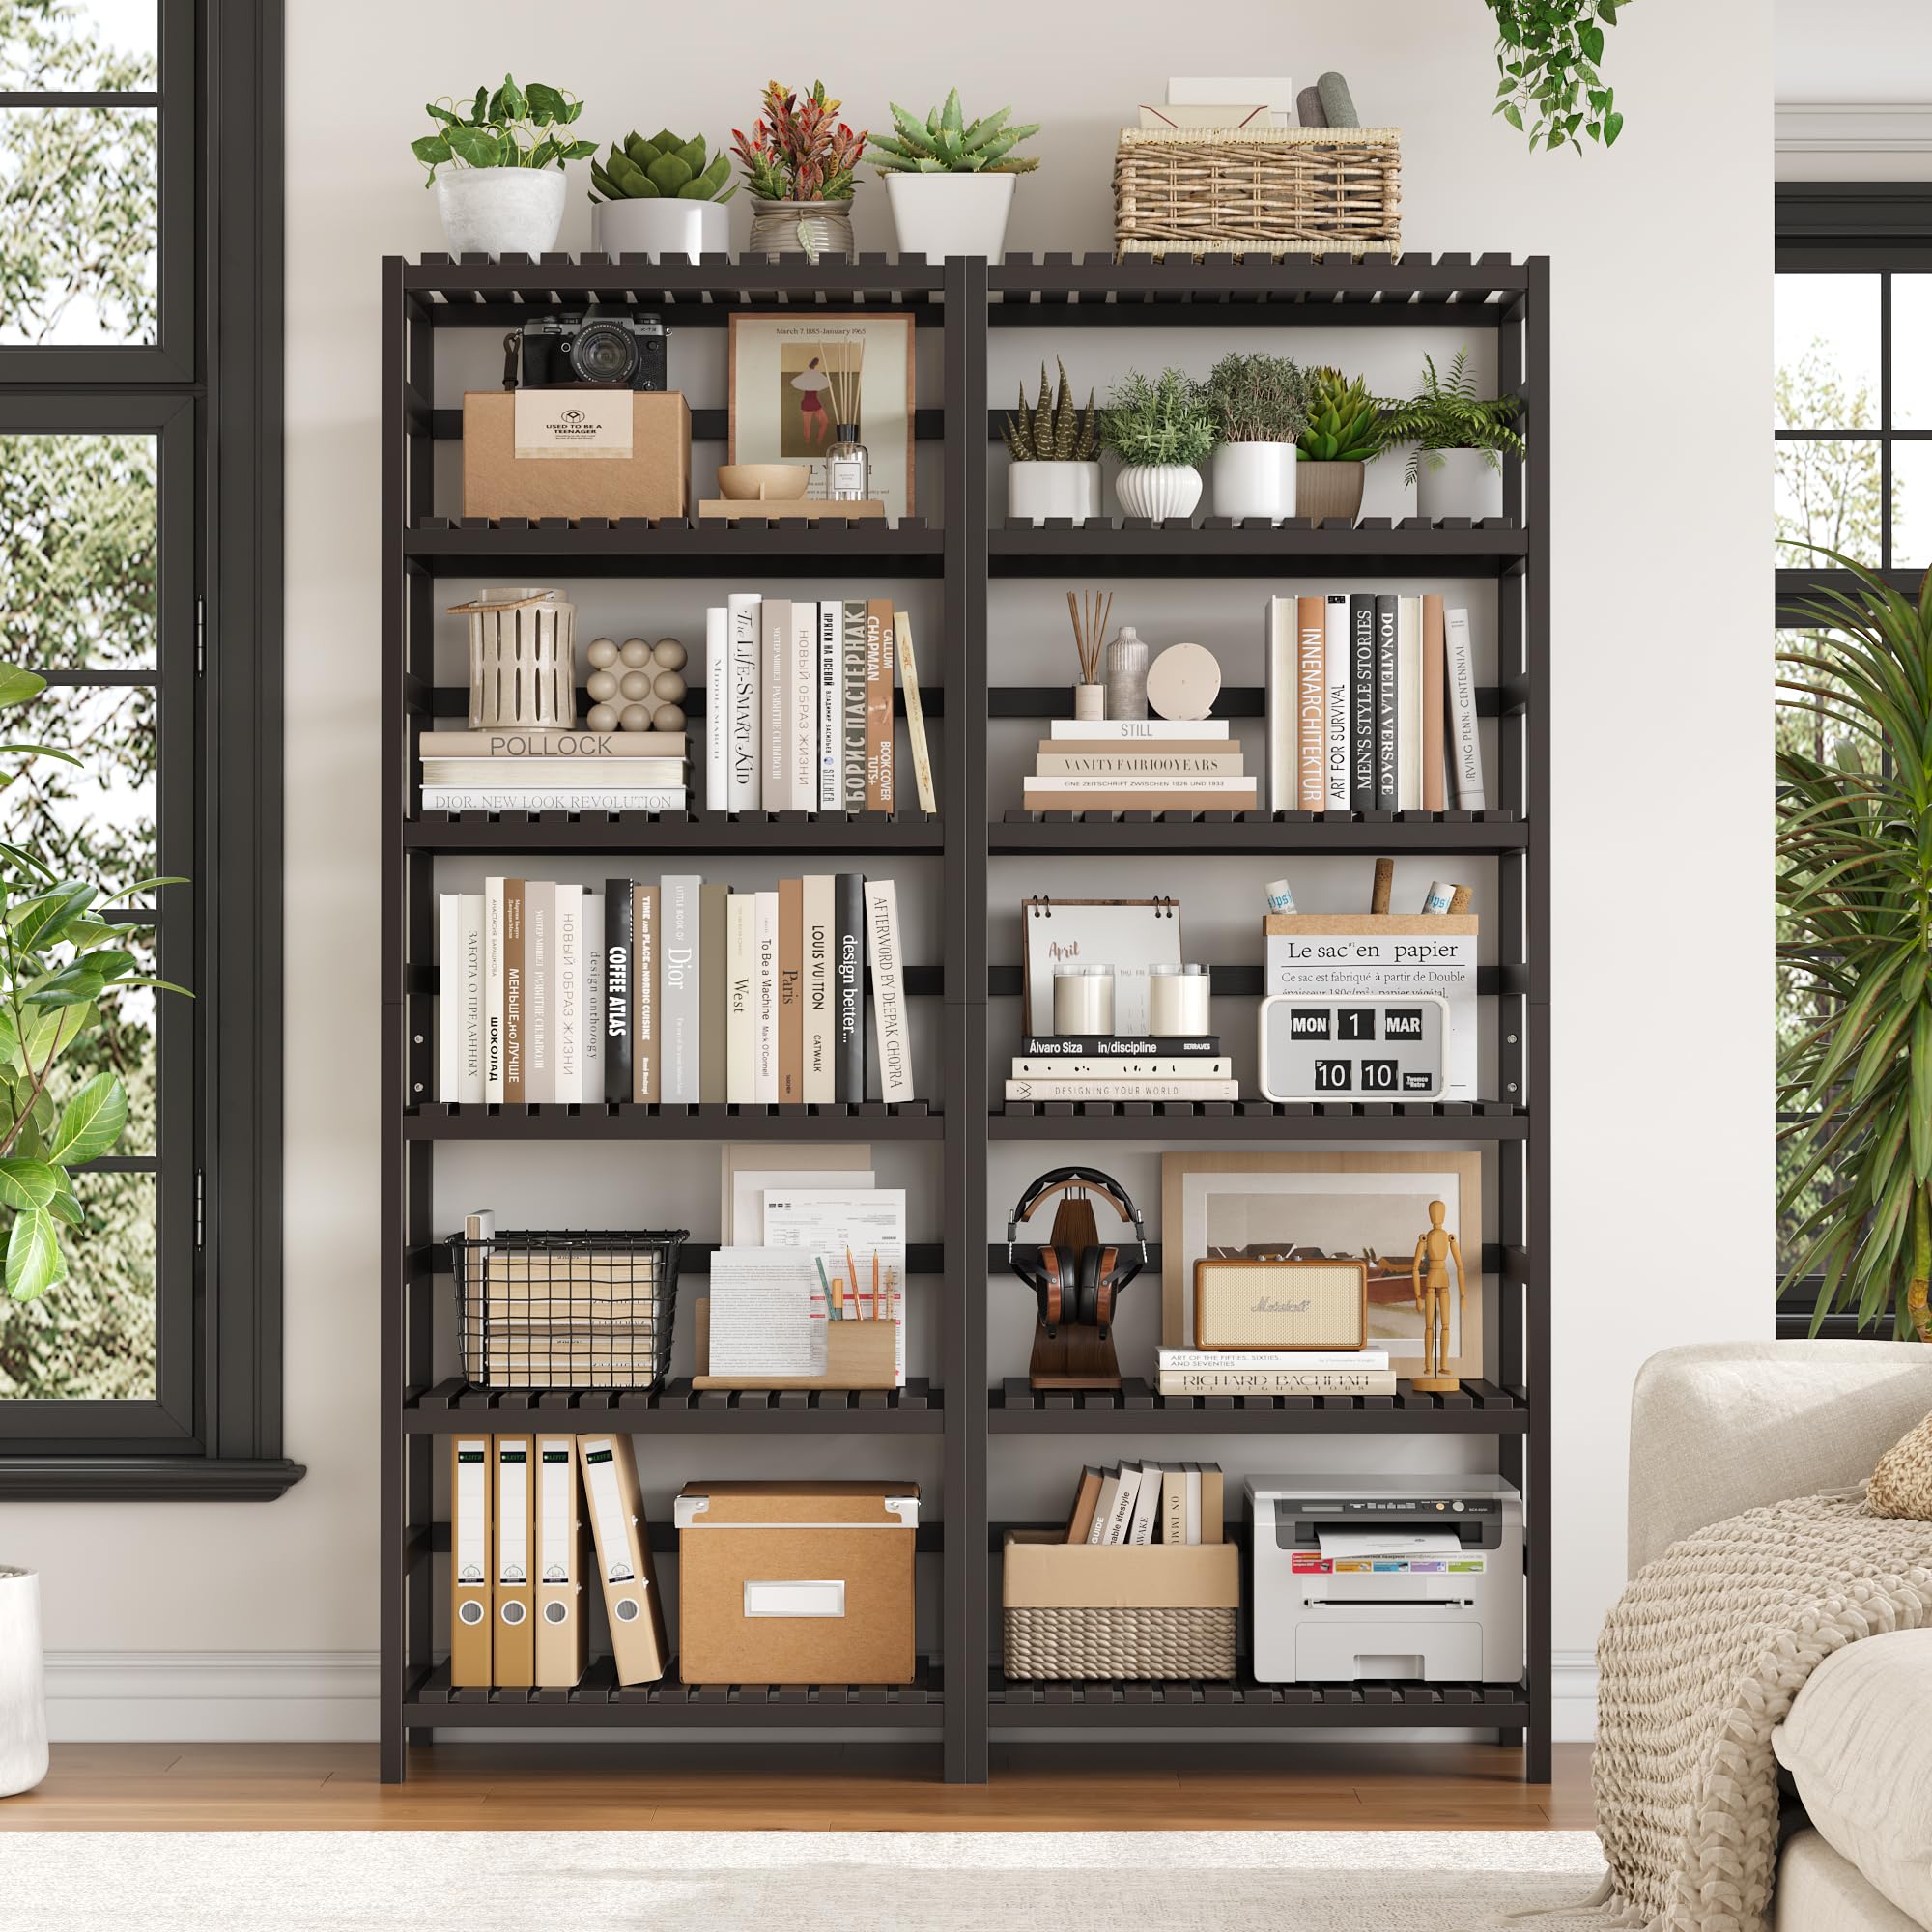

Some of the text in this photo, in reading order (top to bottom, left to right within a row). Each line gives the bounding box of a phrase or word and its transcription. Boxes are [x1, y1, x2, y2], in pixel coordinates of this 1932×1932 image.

[737, 610, 753, 639] The
[823, 613, 835, 687] ПРЯТКИ НА ОСЕВОЙ
[867, 616, 879, 681] CHAPMAN
[883, 629, 893, 668] CALLUM
[1356, 610, 1372, 680] STORIES
[798, 630, 810, 785] НОВЫЙ ОБРАЗ ЖИЗНИ
[845, 611, 866, 802] БОРИС ПАСТЕРНАК
[1302, 628, 1321, 801] INNENARCHITEKTUR
[1356, 683, 1372, 735] STYLE
[1381, 612, 1394, 795] DONATELLA VERSACE
[1456, 644, 1476, 782] IRVING PENN: CENTENNIAL
[491, 735, 613, 755] POLLOCK
[1121, 724, 1153, 737] STILL
[1330, 684, 1346, 800] ART FOR SURVIVAL
[881, 741, 892, 801] BOOK COVER
[1065, 759, 1113, 771] VANITY
[435, 795, 672, 809] DIOR. NEW LOOK REVOLUTION
[642, 895, 651, 920] TIME
[676, 886, 685, 907] LITTLE
[676, 910, 685, 929] BOOK
[761, 939, 772, 951] To
[761, 953, 772, 967] Be
[839, 934, 858, 984] design
[1048, 940, 1080, 962] April
[1287, 942, 1312, 959] Le
[1356, 945, 1380, 957] en
[1394, 941, 1459, 963] papier
[668, 948, 692, 989] Dior
[812, 925, 824, 1009] LOUIS VUITTON
[1281, 971, 1465, 987] Ce sac est fabriqué à partir de Double
[468, 930, 478, 1077] ЗАБОТА О ПРЕДАННЫХ
[563, 913, 576, 1075] НОВЫЙ ОБРАЗ ЖИЗНИ
[587, 951, 600, 1060] design anthology
[609, 946, 626, 1037] COFFEE ATLAS
[734, 979, 749, 1013] West
[761, 979, 772, 1020] Machine
[782, 970, 799, 1005] Paris
[873, 896, 903, 1089] AFTERWORD BY DEEPAK CHOPRA
[1293, 1013, 1421, 1037] MON 1 MAR
[489, 1017, 498, 1082] ШОКОЛАД
[508, 1040, 520, 1083] ЛУЧШЕ
[1029, 1039, 1061, 1054] Álvaro
[1063, 1041, 1083, 1054] Siza
[1098, 1041, 1157, 1056] in/discipline
[1055, 1086, 1179, 1095] DESIGNING YOUR WORLD
[1319, 1065, 1392, 1087] 10 10
[1183, 1375, 1267, 1386] RICHARD
[1115, 1492, 1130, 1522] lifestyle
[1171, 1496, 1179, 1511] ON
[1091, 1516, 1104, 1544] GUIDE
